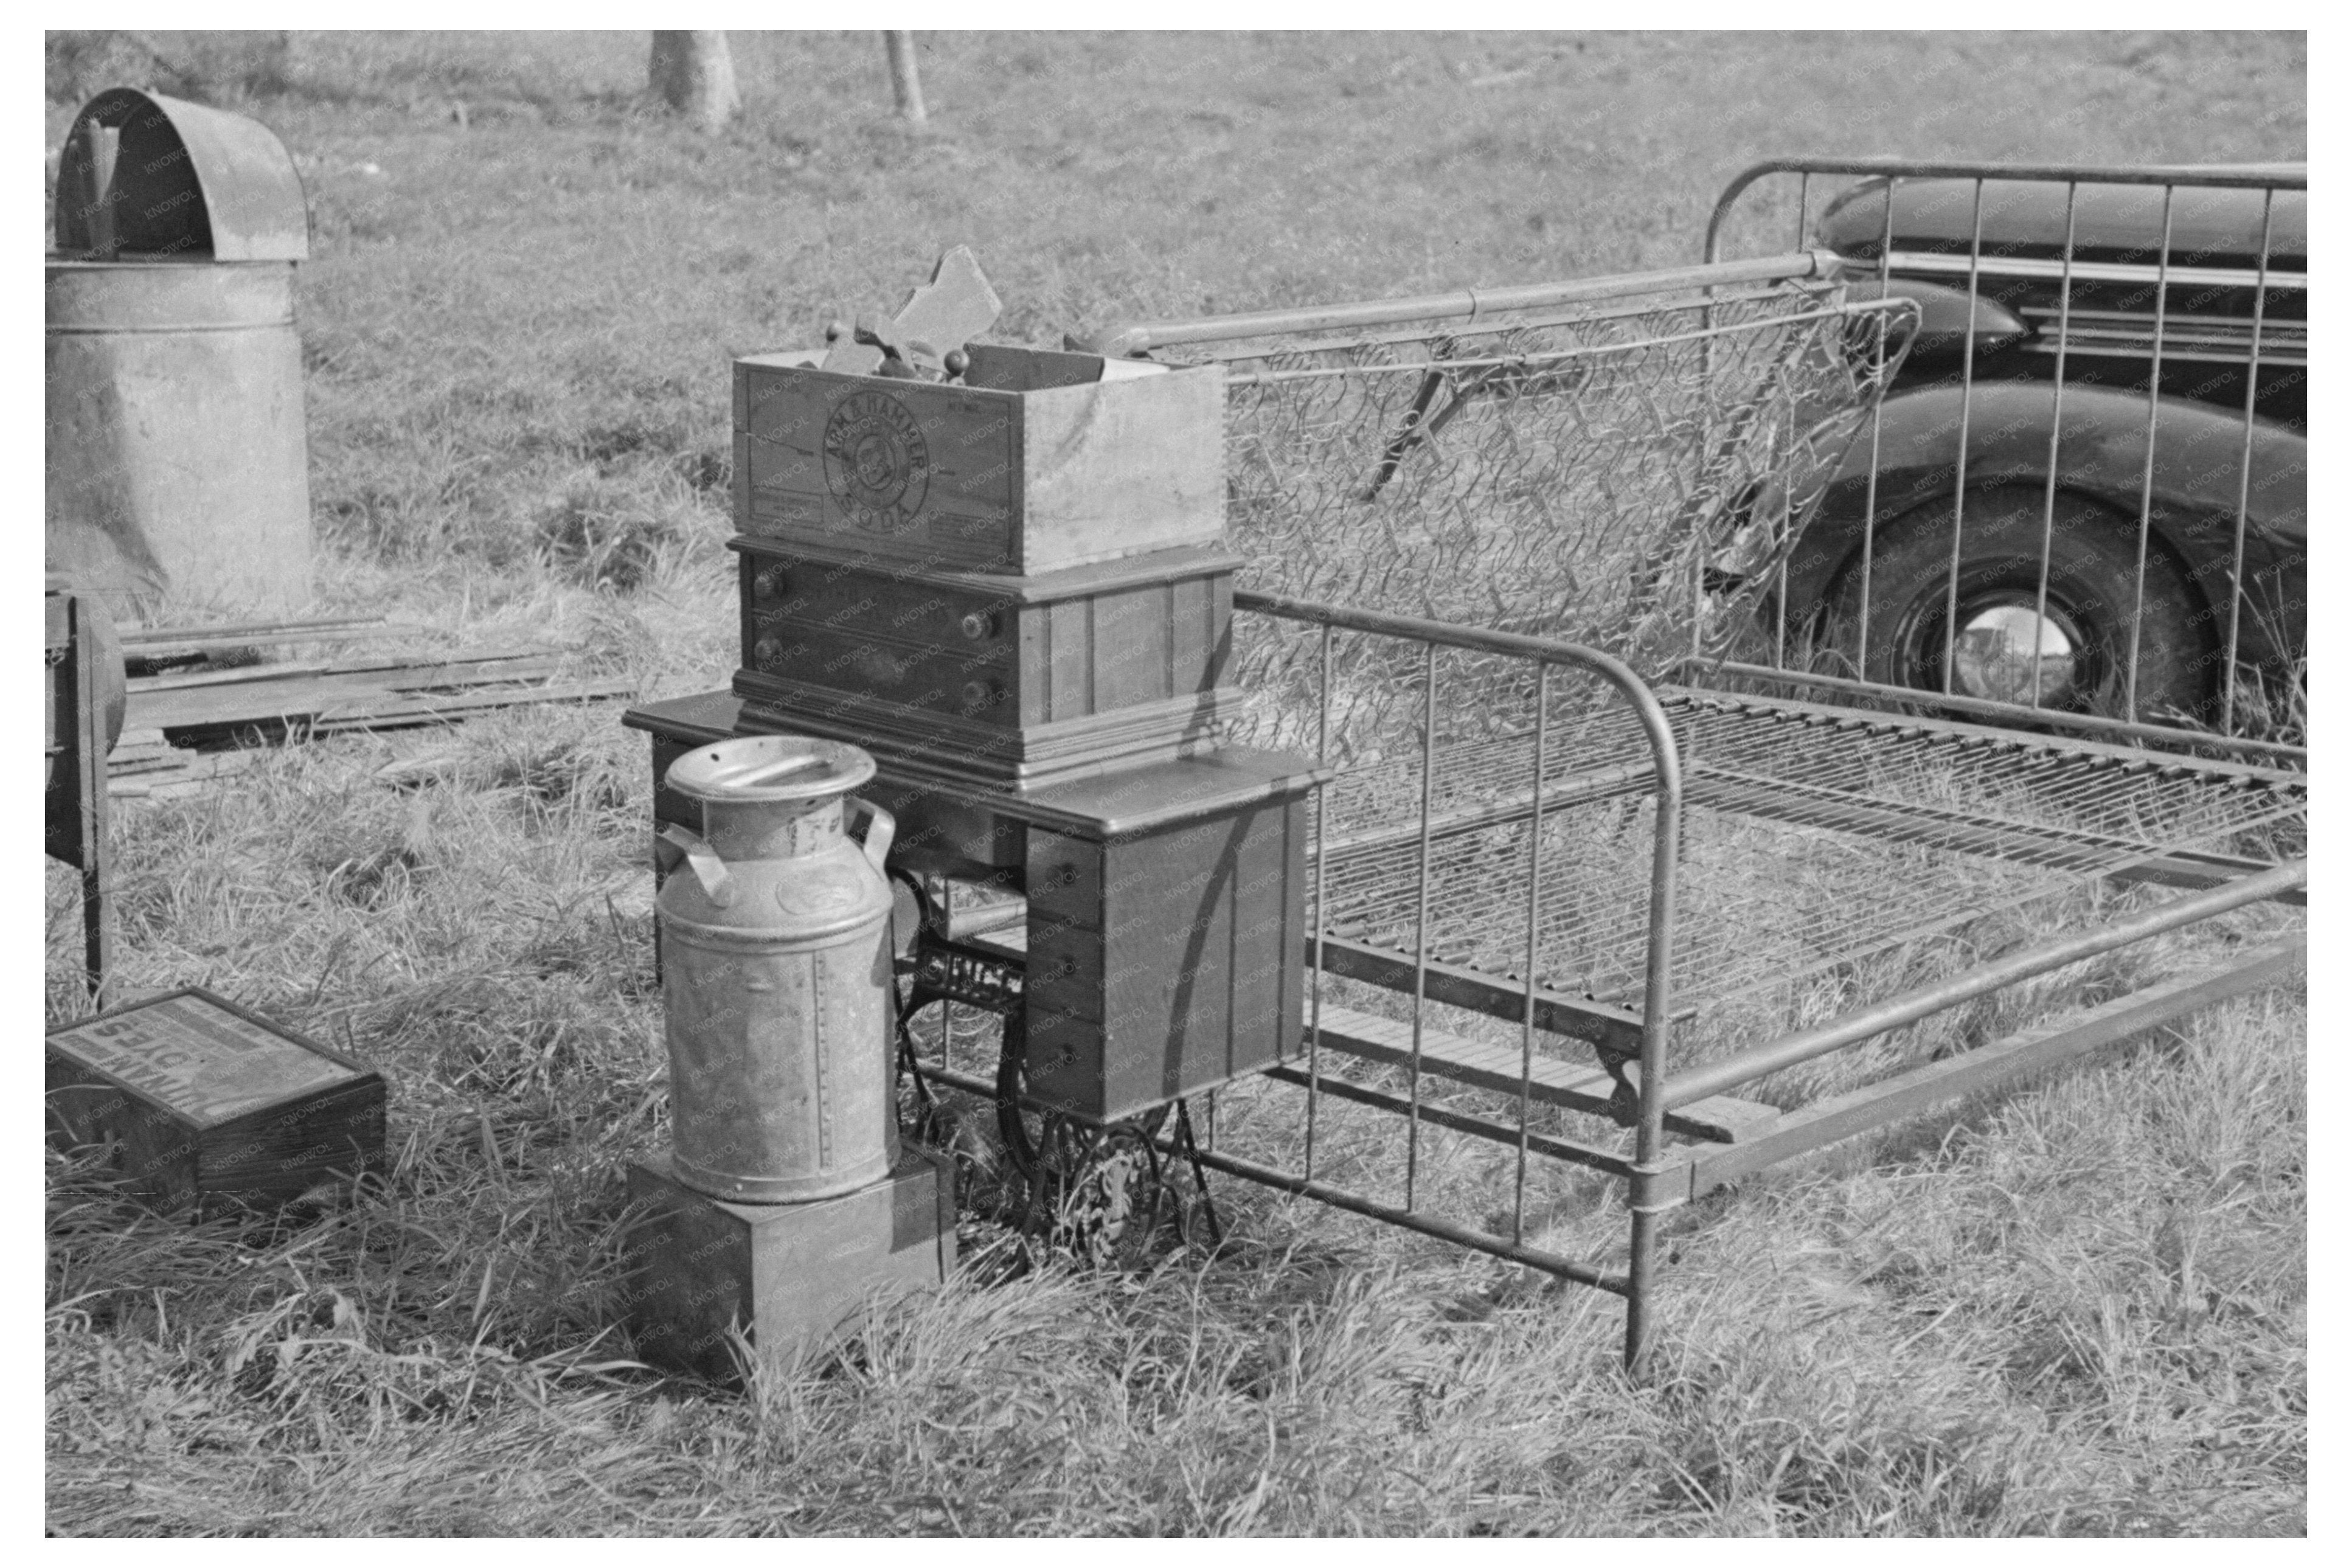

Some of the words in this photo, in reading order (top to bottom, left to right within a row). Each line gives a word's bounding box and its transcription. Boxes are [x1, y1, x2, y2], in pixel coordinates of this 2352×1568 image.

[827, 413, 849, 459] ARM
[850, 398, 861, 416] &
[867, 395, 924, 469] HAMMER
[840, 491, 911, 528] SODA
[92, 1021, 193, 1069] DYES
